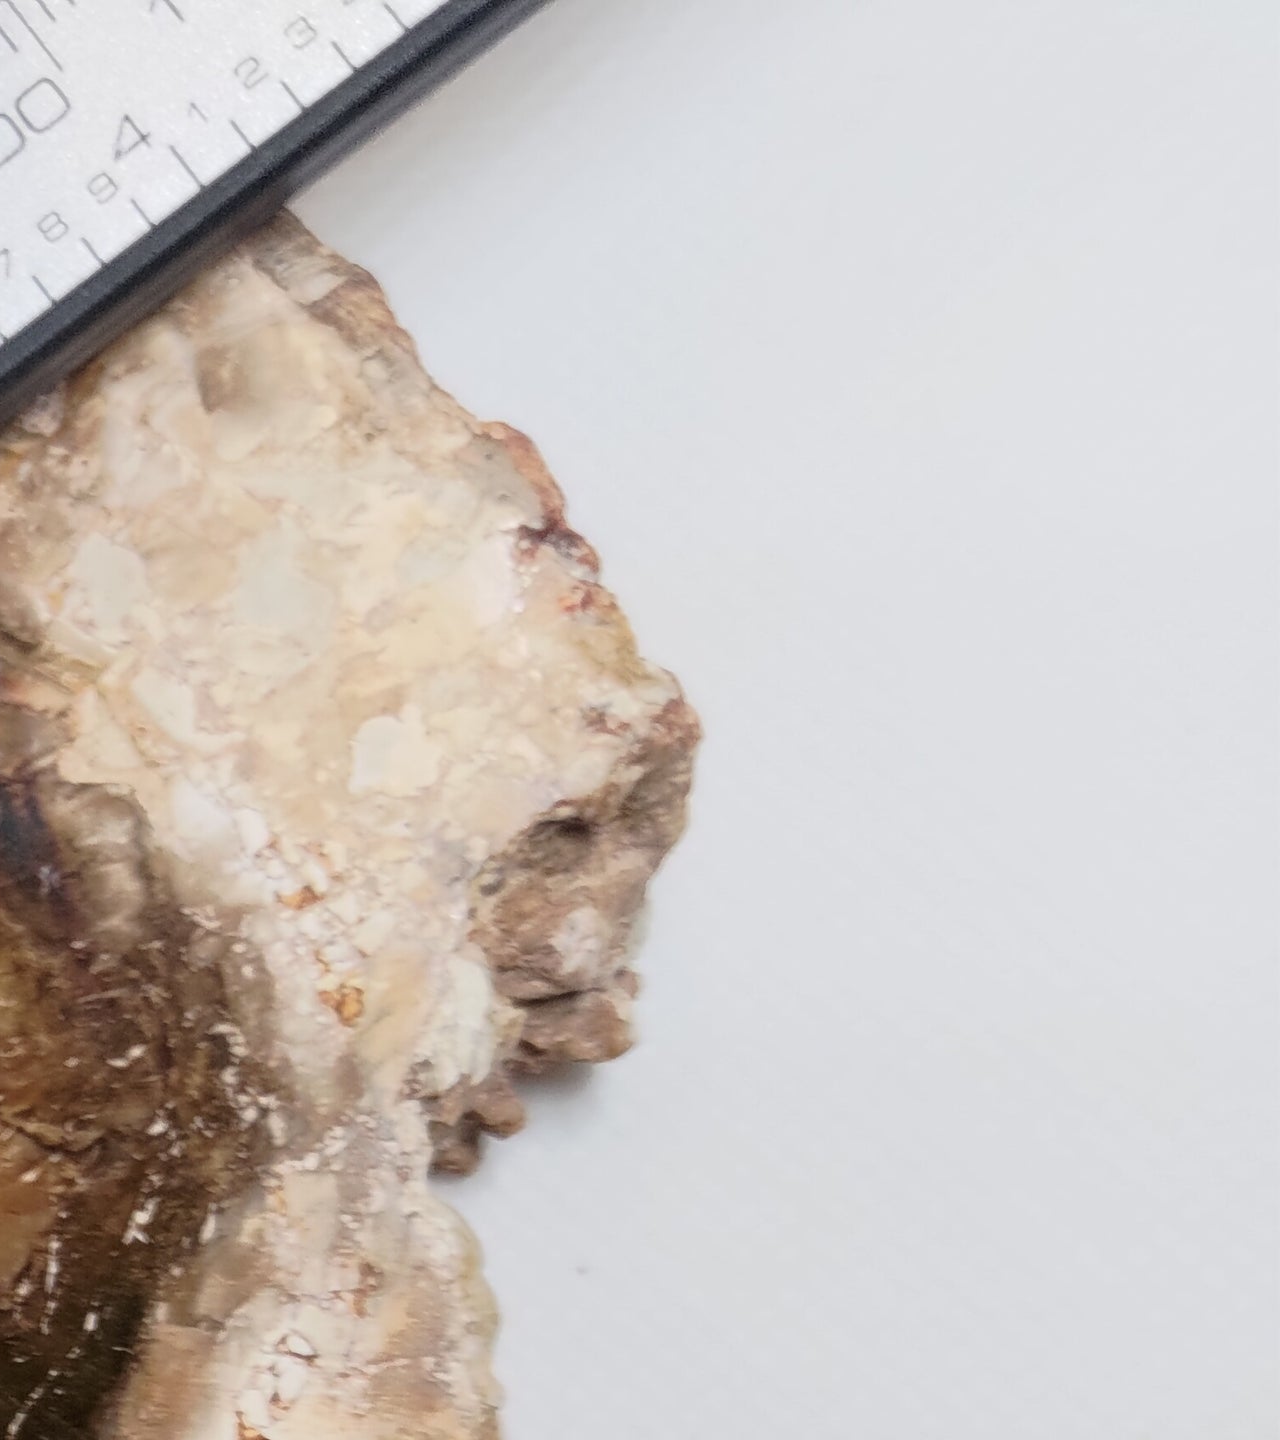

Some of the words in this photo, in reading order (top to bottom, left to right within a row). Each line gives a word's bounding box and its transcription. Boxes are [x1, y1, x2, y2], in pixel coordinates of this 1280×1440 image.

[37, 210, 70, 243] 8
[86, 171, 119, 205] 9
[113, 113, 152, 161] 4
[188, 101, 209, 123] 1
[233, 56, 270, 90] 2
[283, 15, 318, 50] 3
